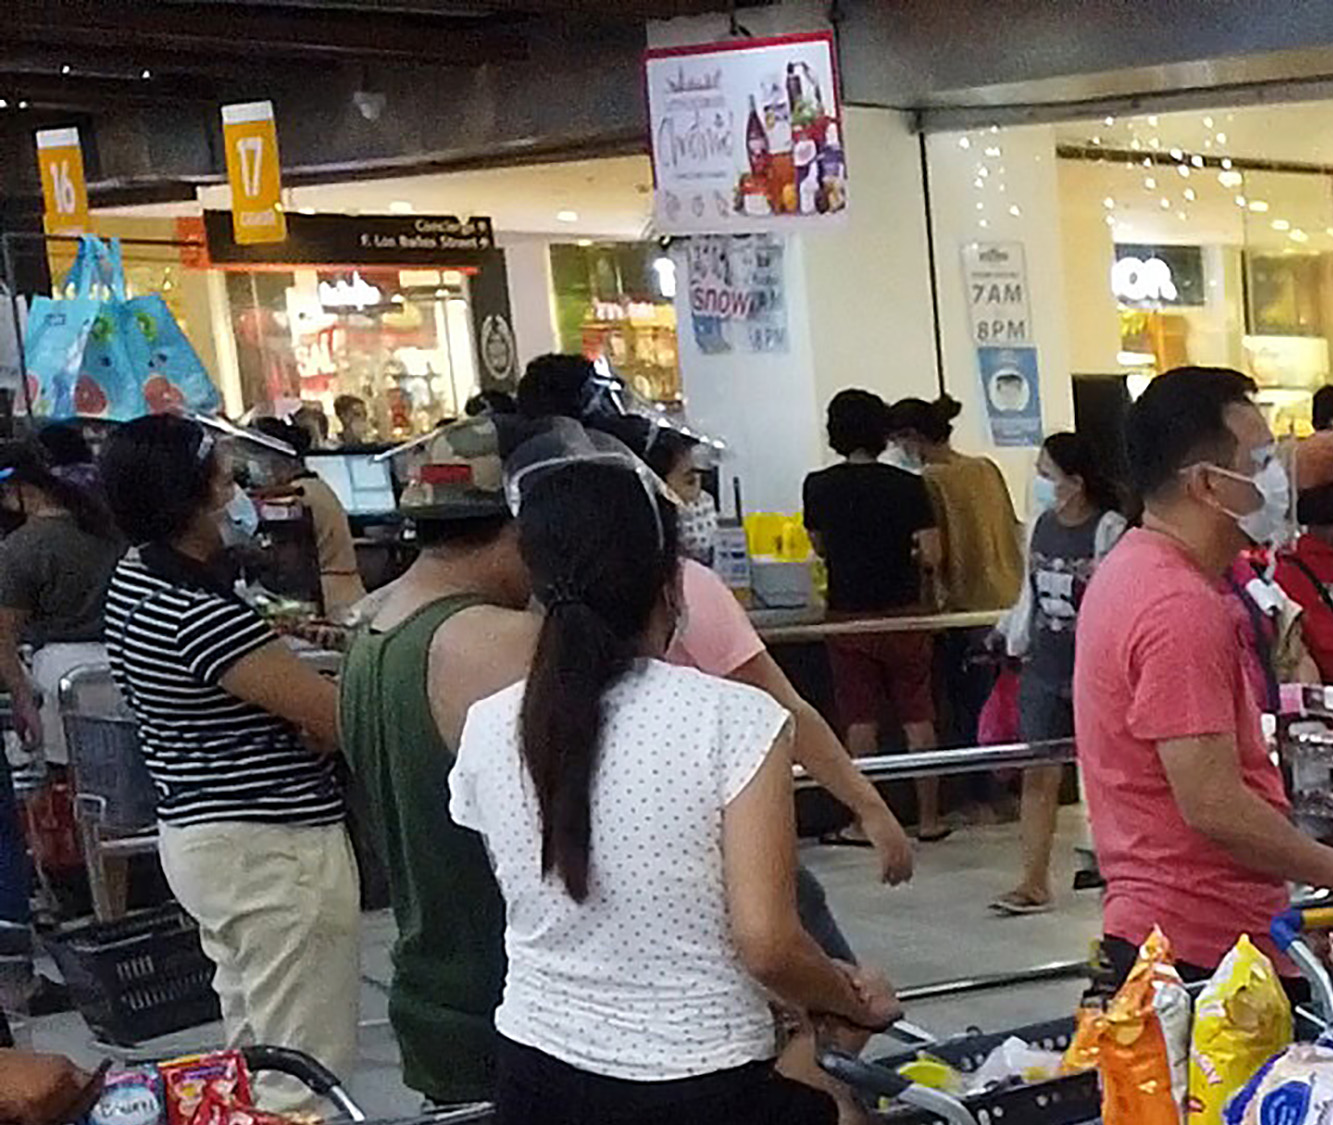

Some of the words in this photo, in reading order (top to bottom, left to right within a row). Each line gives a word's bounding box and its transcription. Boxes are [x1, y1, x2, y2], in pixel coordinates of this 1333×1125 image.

[235, 136, 263, 198] 17
[49, 160, 77, 214] 16
[691, 285, 750, 319] snow
[971, 283, 1023, 304] 7AM
[976, 319, 1026, 341] 8PM
